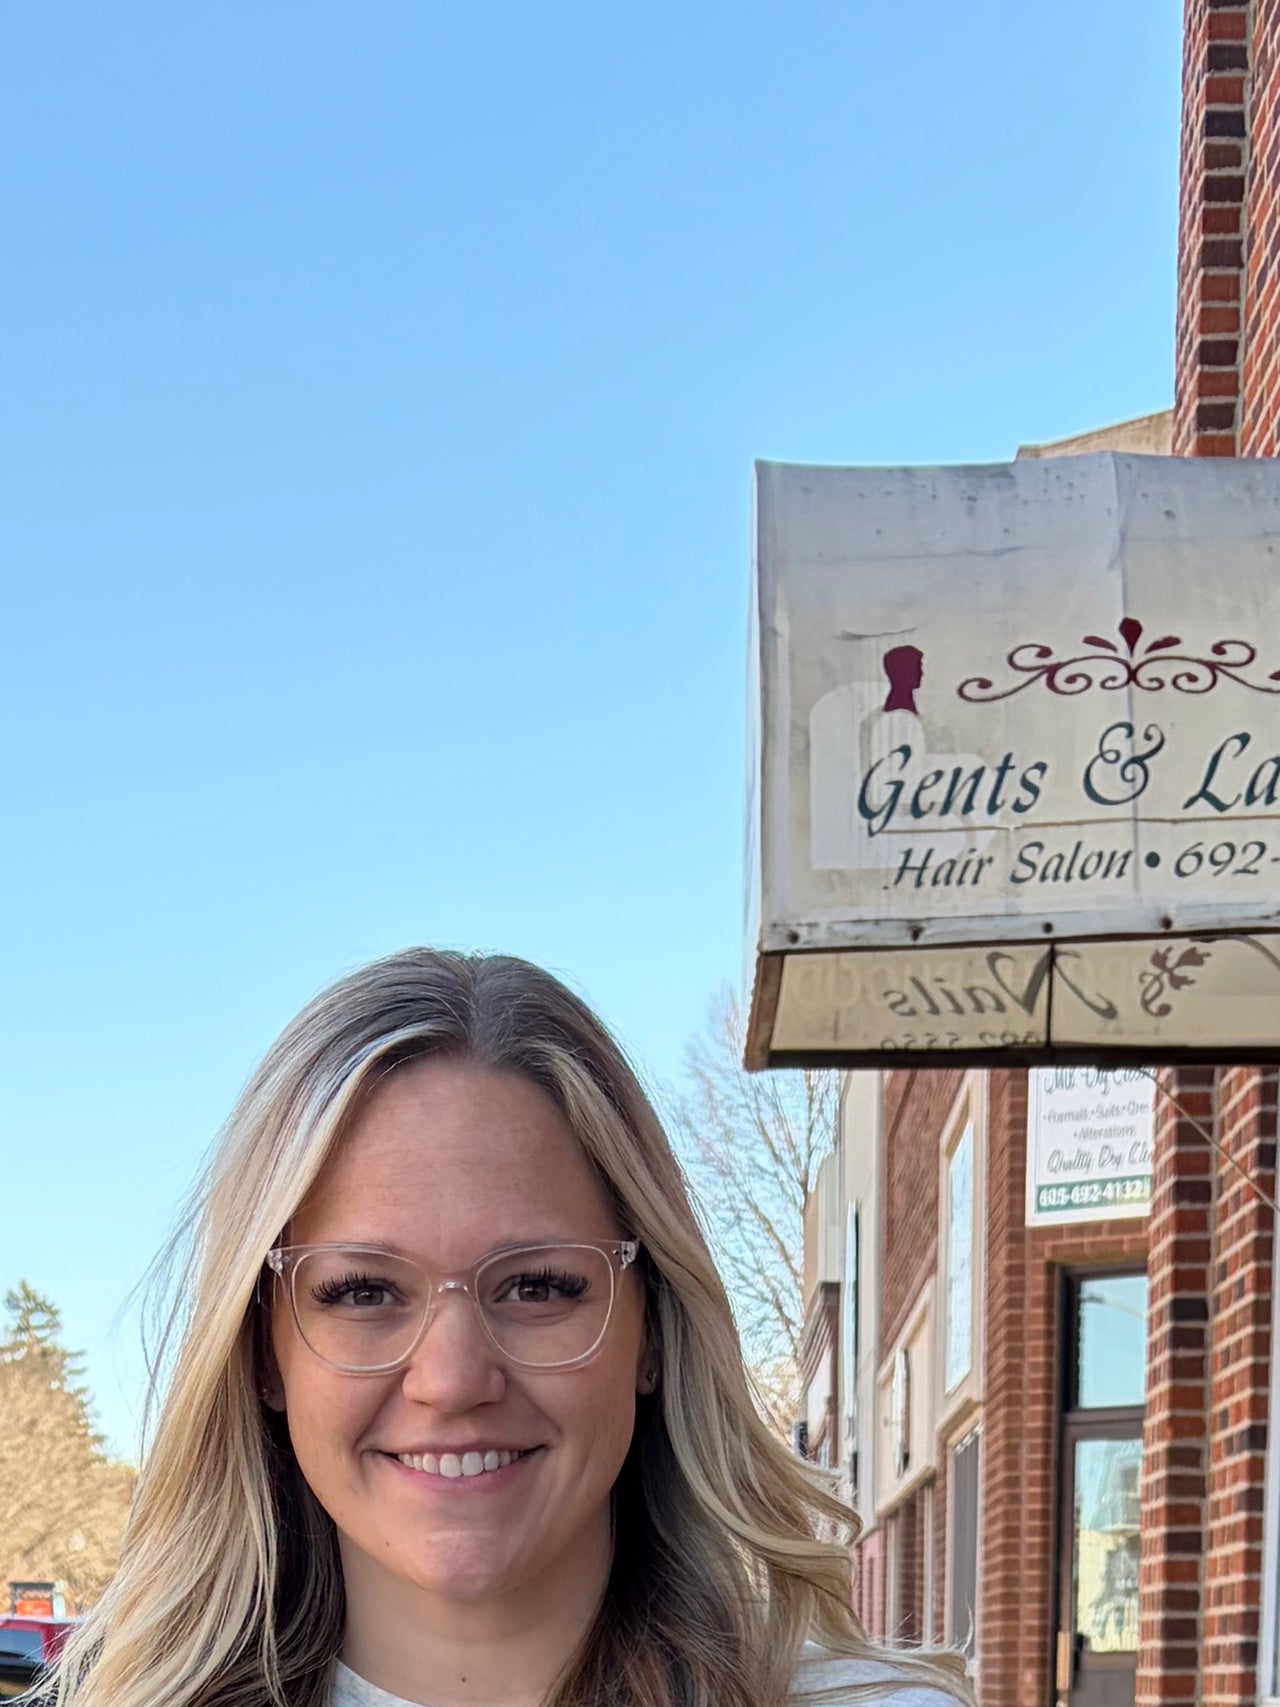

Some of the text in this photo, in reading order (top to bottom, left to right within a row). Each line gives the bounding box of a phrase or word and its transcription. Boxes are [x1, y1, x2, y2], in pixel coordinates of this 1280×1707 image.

[856, 744, 1049, 838] Gents
[1082, 721, 1166, 806] &
[892, 847, 994, 889] Hair
[1009, 840, 1133, 885] Salon
